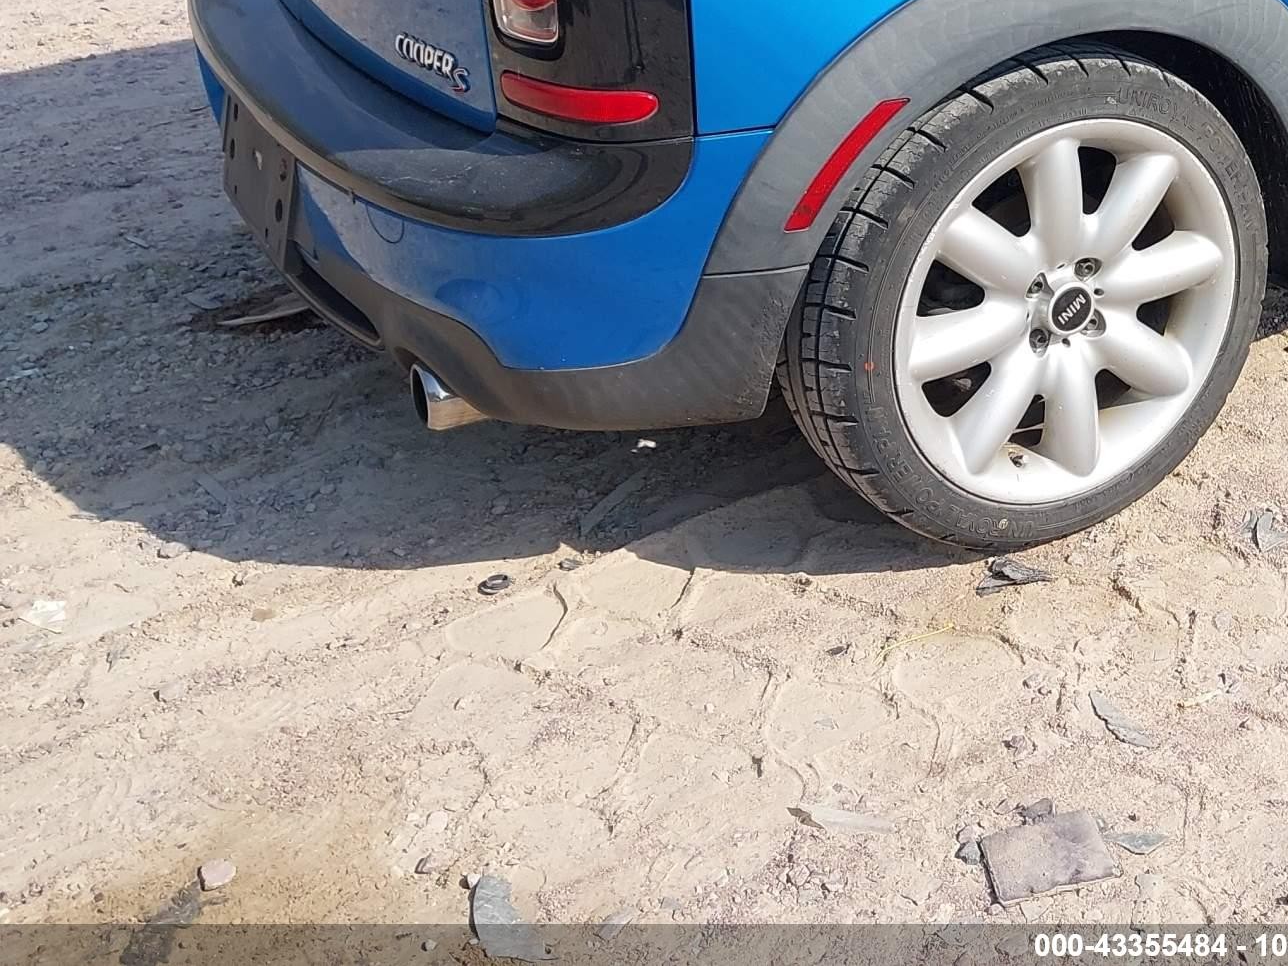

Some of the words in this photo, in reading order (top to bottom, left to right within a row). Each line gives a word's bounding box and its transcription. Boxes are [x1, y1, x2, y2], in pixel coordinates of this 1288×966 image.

[395, 34, 455, 82] COOPER
[452, 67, 471, 93] S
[1058, 293, 1087, 325] MINI
